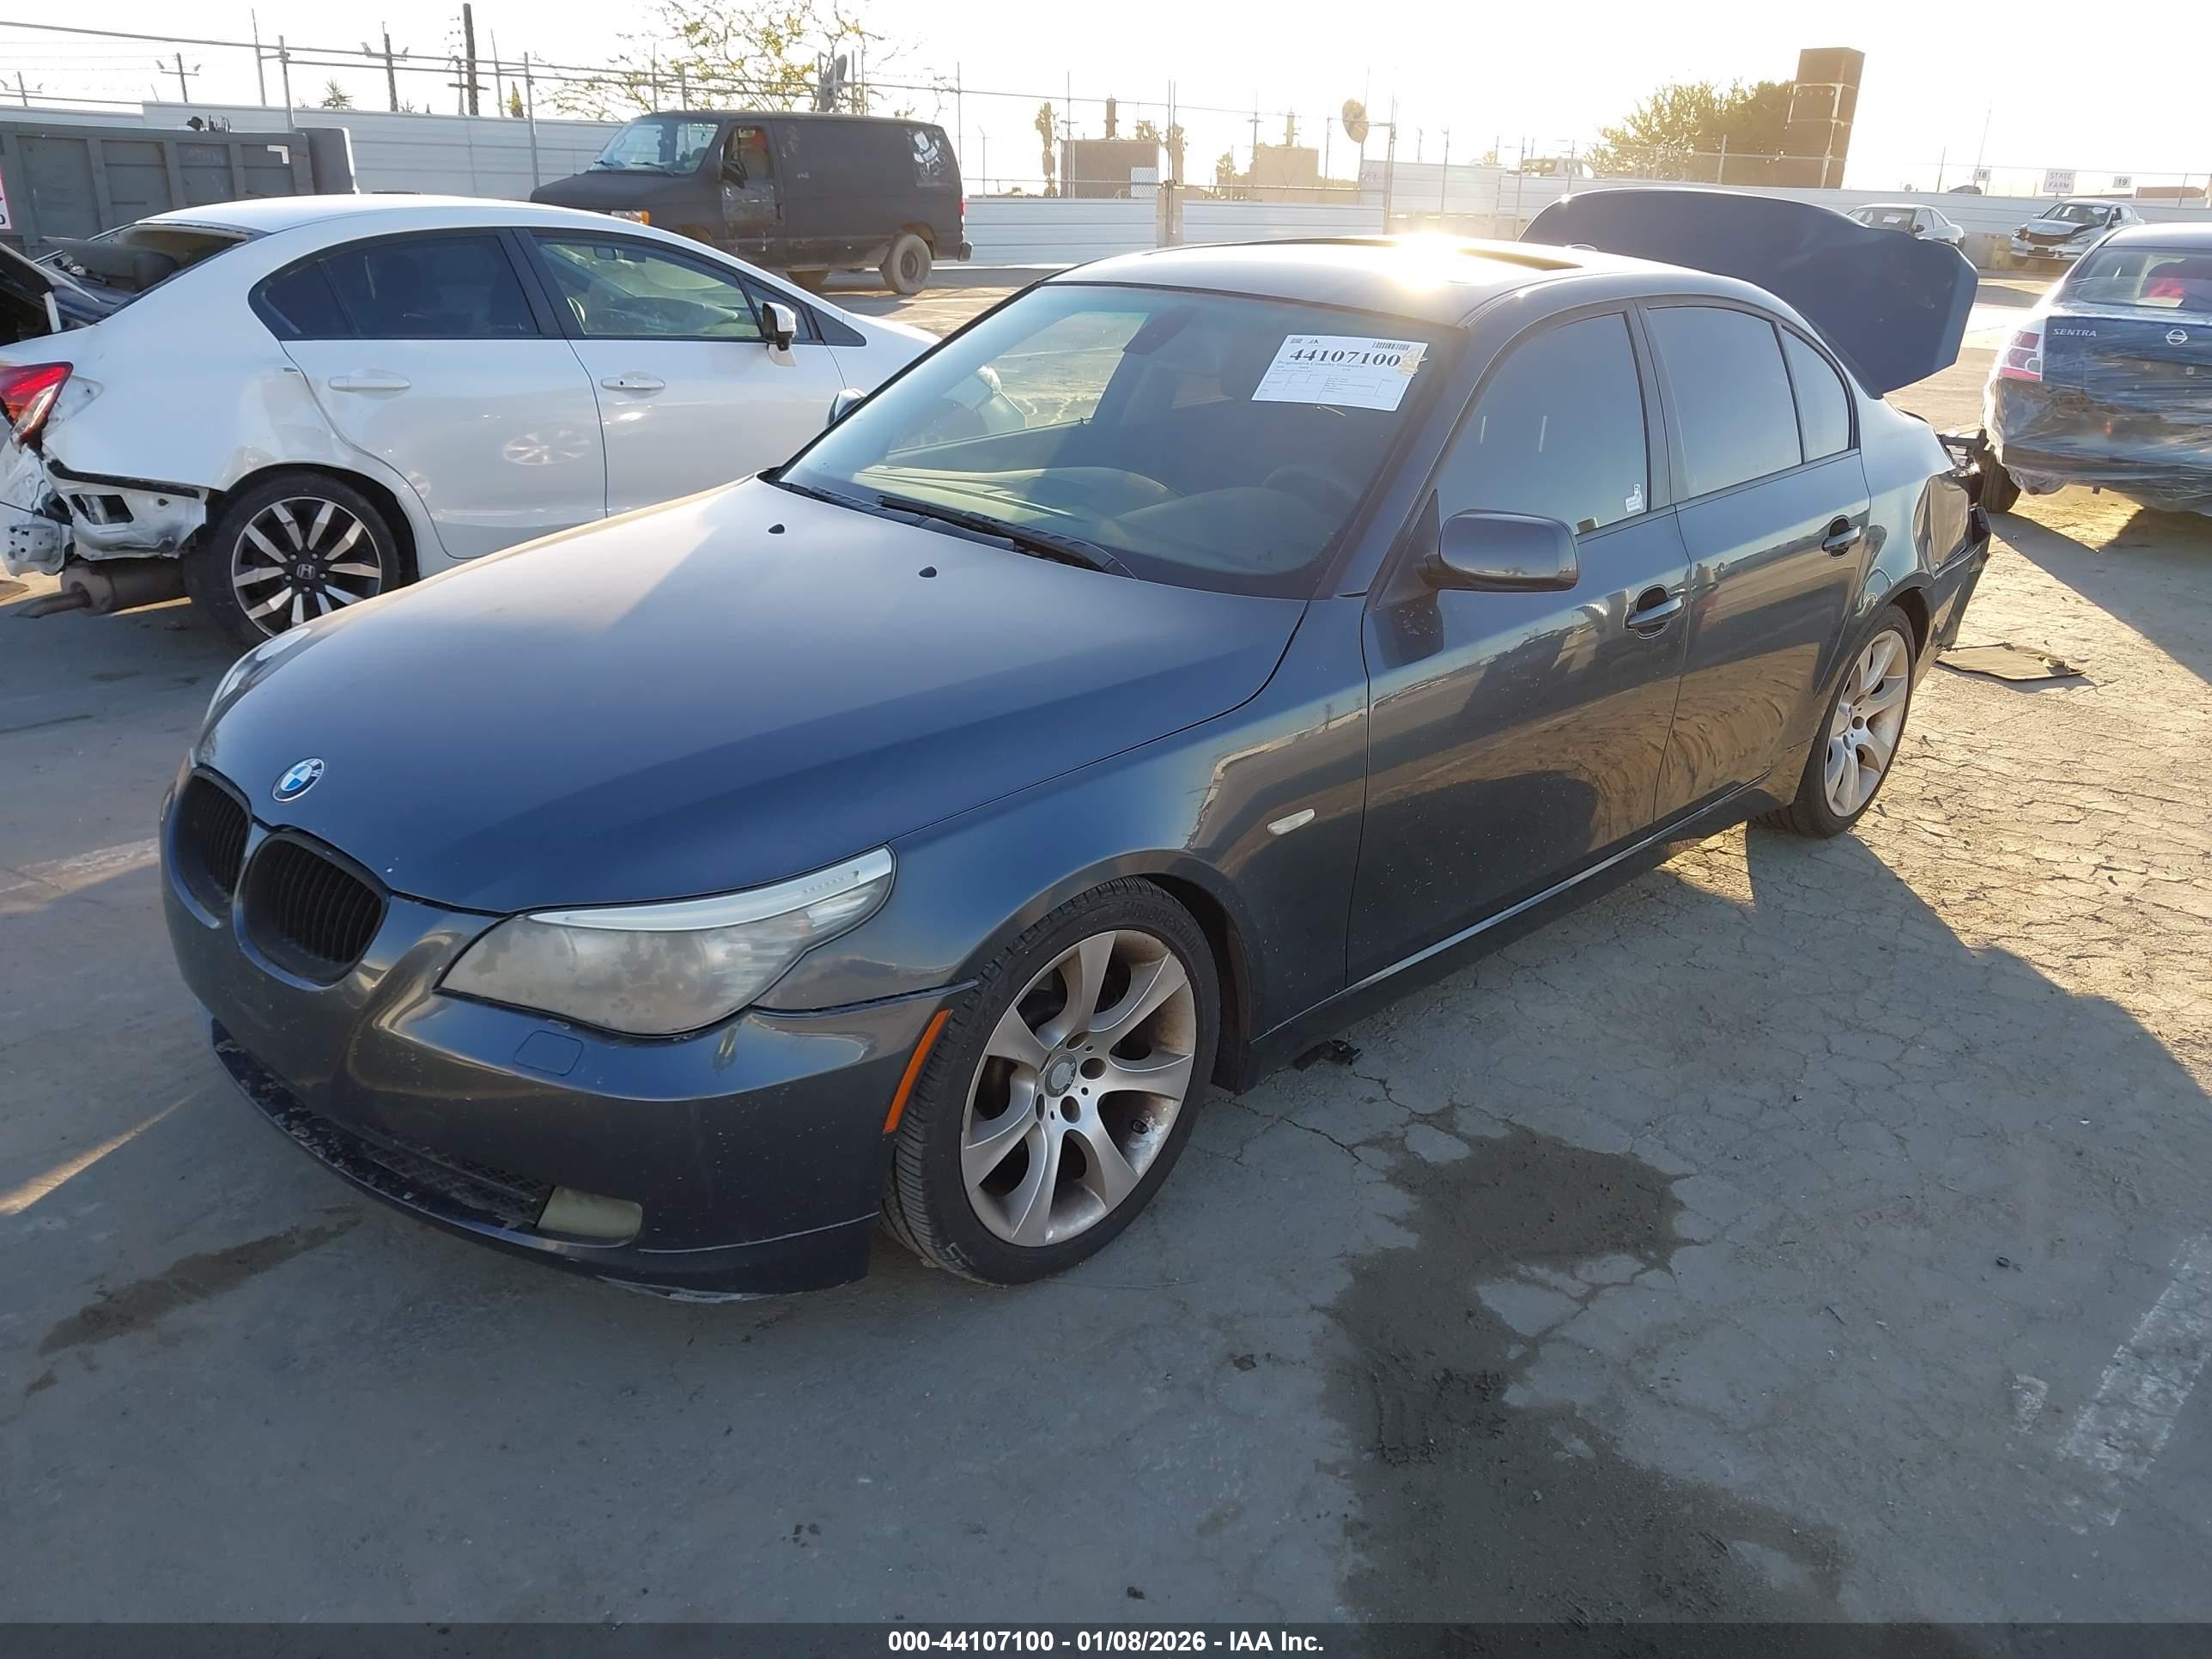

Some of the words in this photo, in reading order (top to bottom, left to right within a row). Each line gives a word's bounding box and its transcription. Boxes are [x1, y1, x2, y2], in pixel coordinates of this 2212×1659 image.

[2049, 172, 2074, 180] STATE
[2048, 181, 2070, 190] FARM
[2117, 178, 2128, 186] 19
[2052, 328, 2097, 337] SENTRA
[1289, 348, 1401, 367] 44107100
